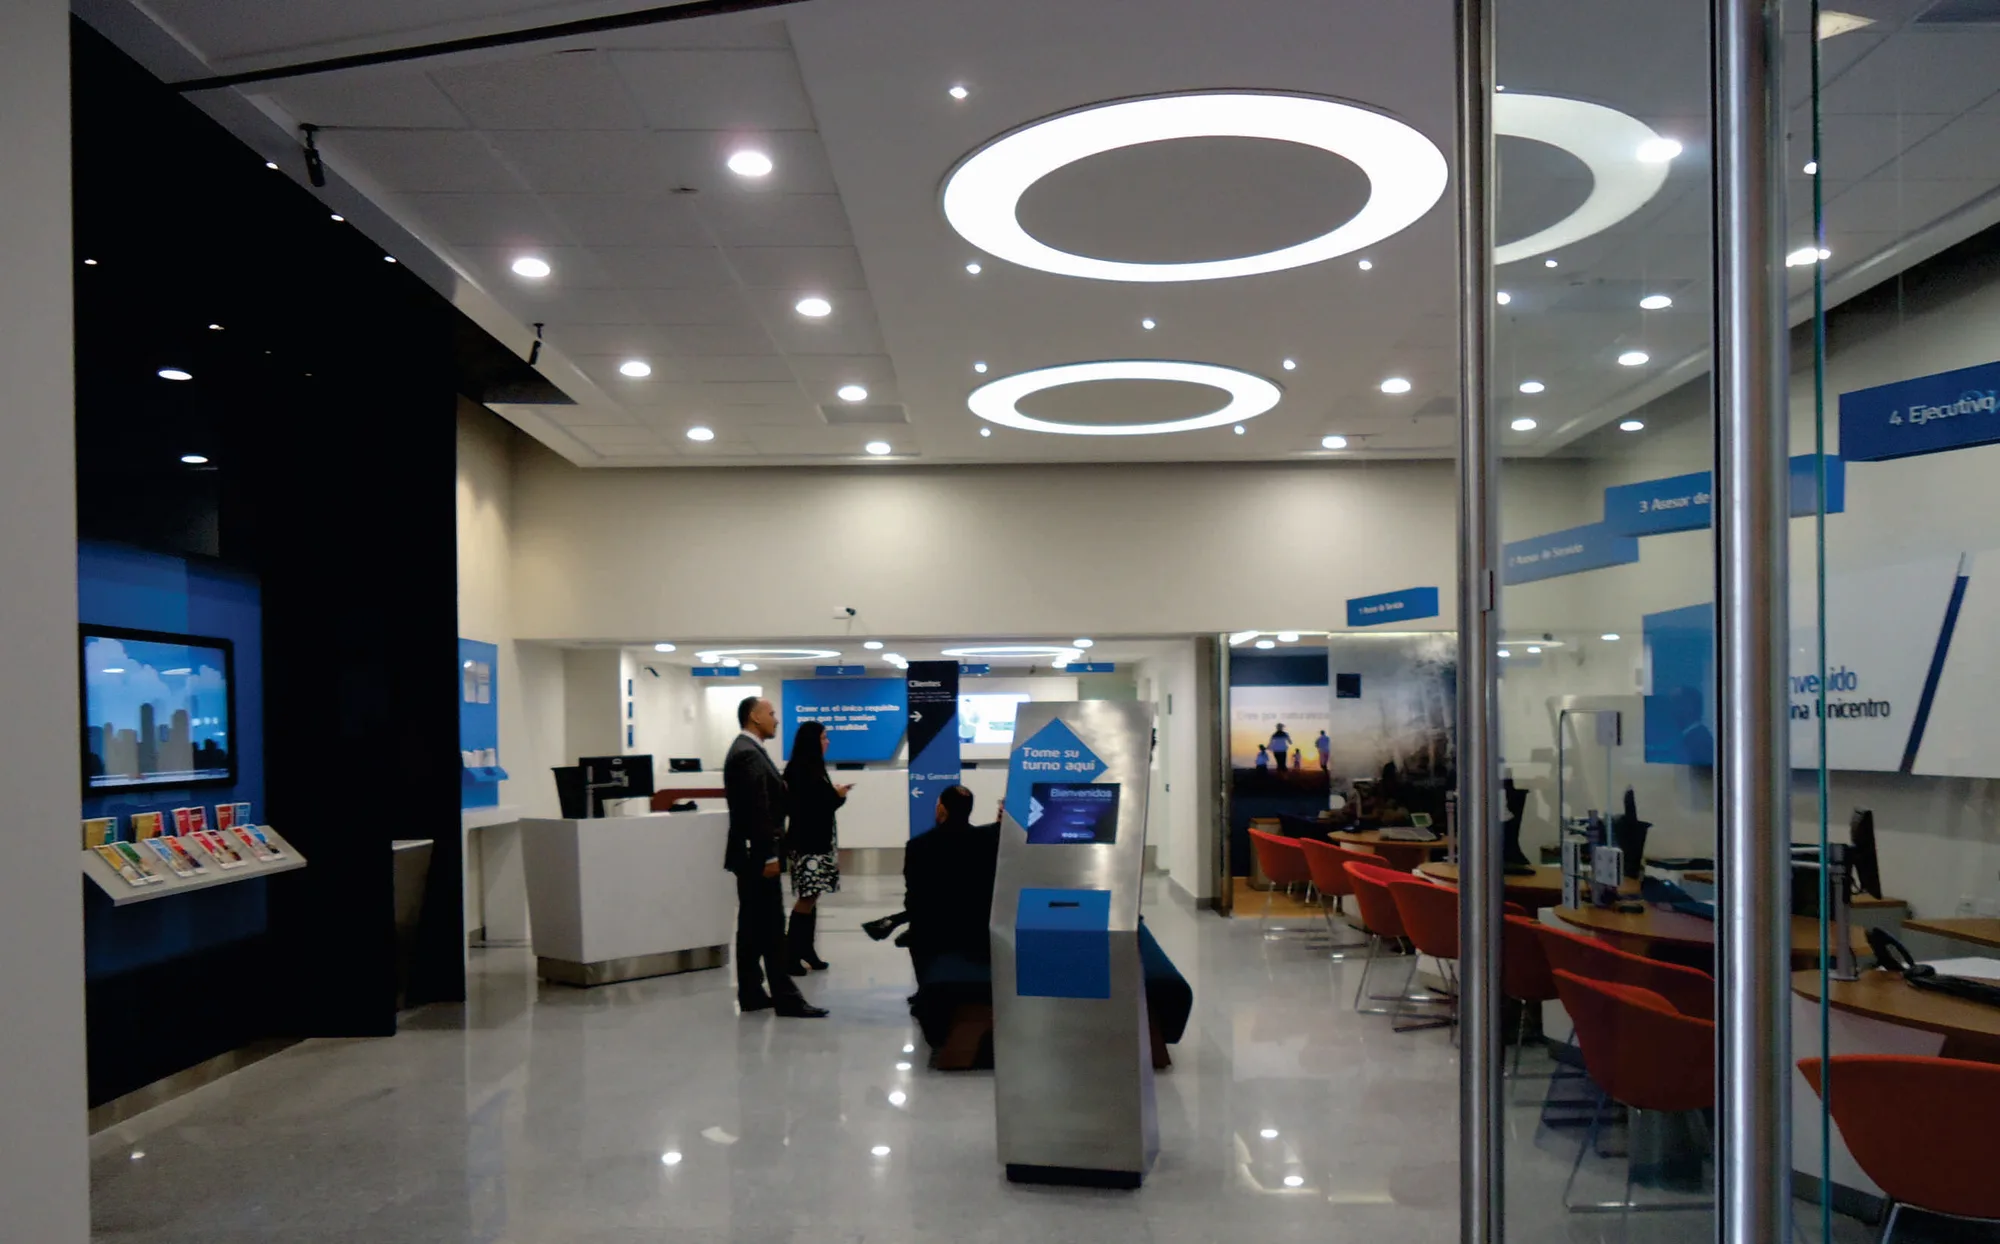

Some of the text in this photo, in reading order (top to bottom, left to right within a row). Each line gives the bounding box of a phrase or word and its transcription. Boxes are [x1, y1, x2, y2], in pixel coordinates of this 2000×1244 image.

[1889, 410, 1903, 426] 4
[1639, 500, 1648, 513] 3
[908, 680, 941, 688] Clientes
[1022, 747, 1079, 758] Tome su
[1022, 759, 1096, 772] turno aquí
[1050, 788, 1112, 798] Bienvenidos
